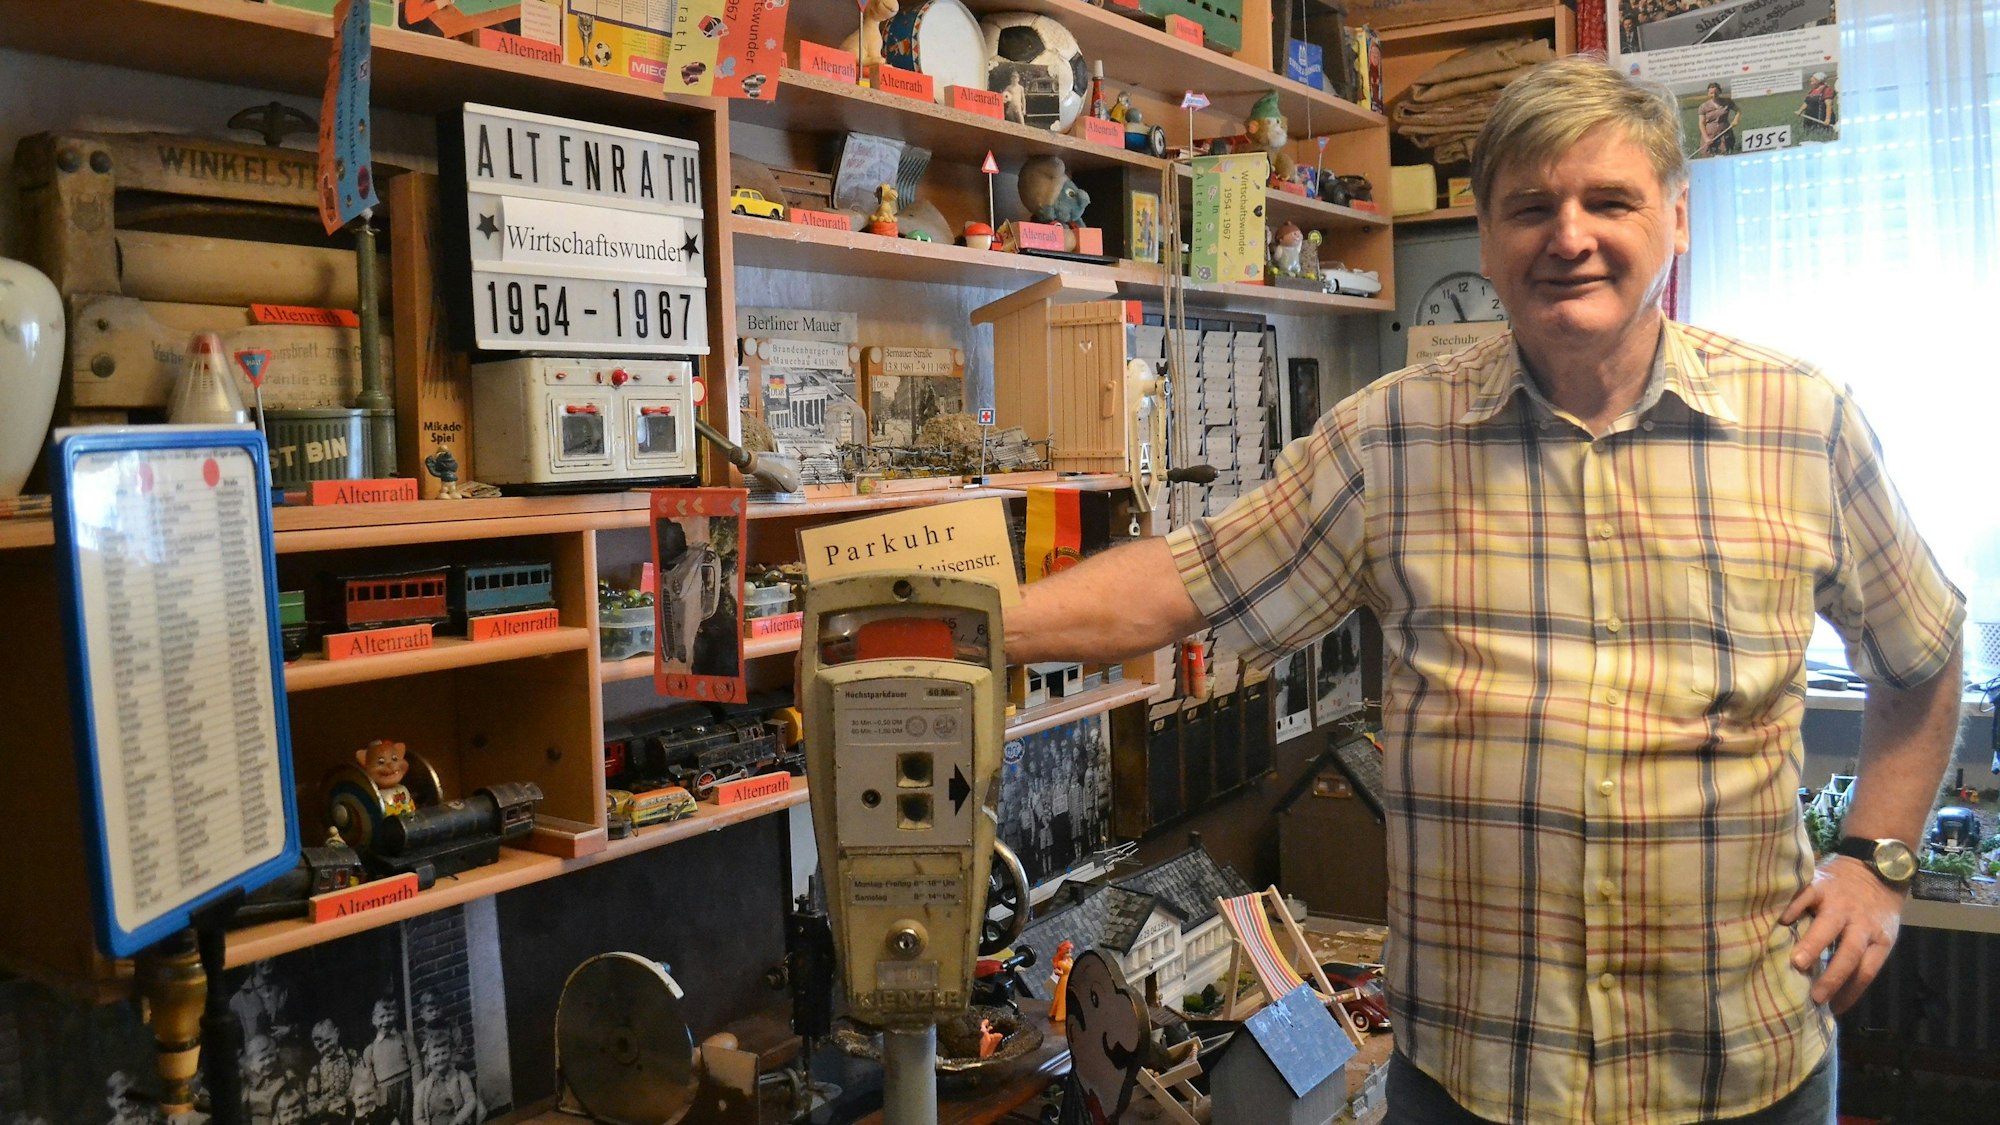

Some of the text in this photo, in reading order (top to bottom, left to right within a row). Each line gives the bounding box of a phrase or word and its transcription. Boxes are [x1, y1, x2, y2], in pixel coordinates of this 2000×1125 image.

[496, 37, 561, 64] Altenrath
[811, 56, 857, 78] Altenrath
[880, 73, 923, 94] Altenrath
[960, 87, 1000, 107] Altenrath
[1744, 130, 1786, 148] 1956
[477, 124, 699, 204] ALTENRATH
[801, 213, 848, 231] Altenrath
[1238, 170, 1249, 256] Wirtschaftswunder
[505, 224, 684, 263] Wirtschaftswunder
[1022, 228, 1057, 242] Altenrath
[1442, 289, 1450, 299] 11
[1458, 282, 1468, 293] 12
[1481, 286, 1486, 296] 1
[488, 281, 570, 336] 1954
[613, 288, 692, 341] 1967
[1429, 304, 1440, 314] 10
[1492, 299, 1500, 310] 2
[262, 307, 342, 325] Altenrath
[747, 315, 842, 334] Berliner Mauer
[1431, 334, 1480, 347] Stechuhr
[431, 432, 455, 445] Spiel
[305, 437, 348, 464] BIN
[334, 484, 415, 505] Altenrath
[823, 524, 956, 567] Parkuhr
[490, 613, 558, 638] Altenrath
[349, 631, 430, 656] Altenrath
[733, 777, 789, 803] Altenrath
[336, 884, 413, 918] Altenrath
